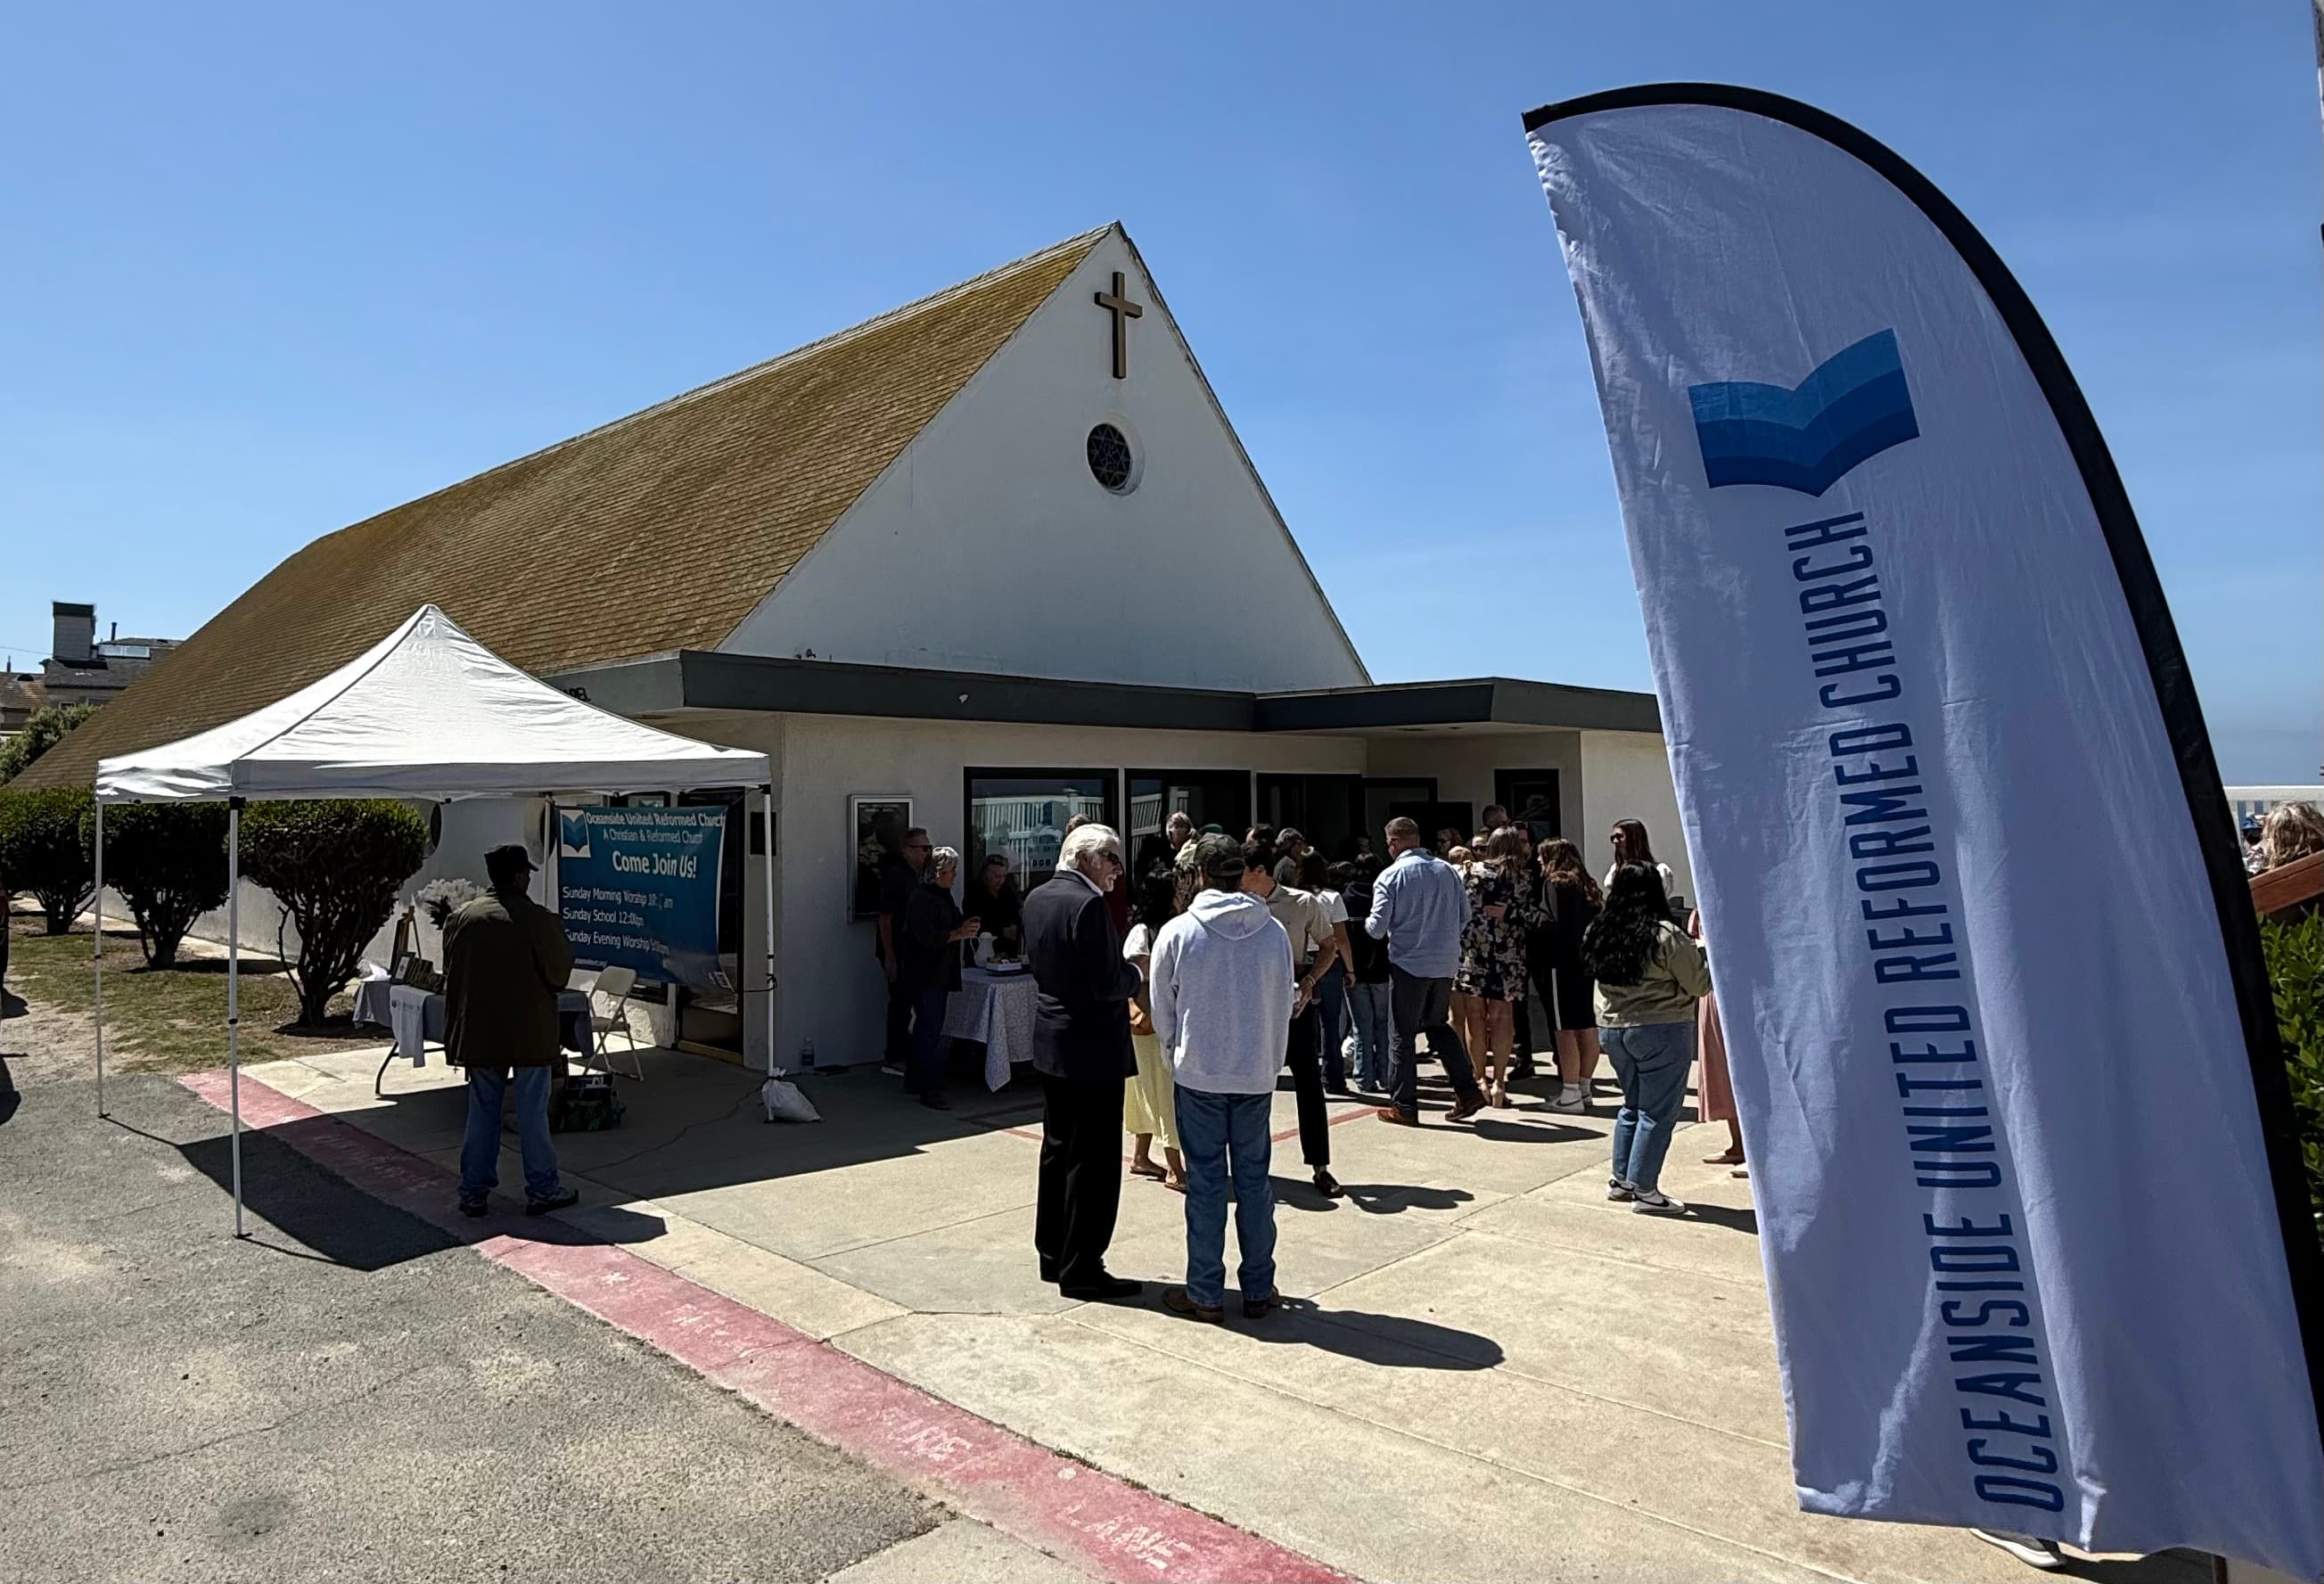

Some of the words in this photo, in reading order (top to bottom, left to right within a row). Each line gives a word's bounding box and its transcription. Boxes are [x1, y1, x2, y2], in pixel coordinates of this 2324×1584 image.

[1784, 511, 1904, 710] CHURCH
[586, 812, 626, 825] Oceanside
[626, 813, 653, 826] United
[654, 813, 697, 827] Reformed
[604, 828, 609, 840] A
[610, 828, 638, 841] Christian
[639, 829, 646, 842] &
[647, 830, 681, 843] Reformed
[612, 849, 650, 874] Come
[653, 852, 677, 877] Join
[679, 855, 697, 880] Us!
[1828, 721, 1962, 985] REFORMED
[563, 886, 592, 903] Sunday
[593, 887, 622, 905] Morning
[563, 907, 592, 923] Sunday
[593, 908, 617, 923] School
[593, 931, 621, 948] Evening
[622, 934, 650, 953] Worship
[1885, 1004, 2004, 1190] UNITED
[1923, 1211, 2065, 1513] OCEANSIDE
